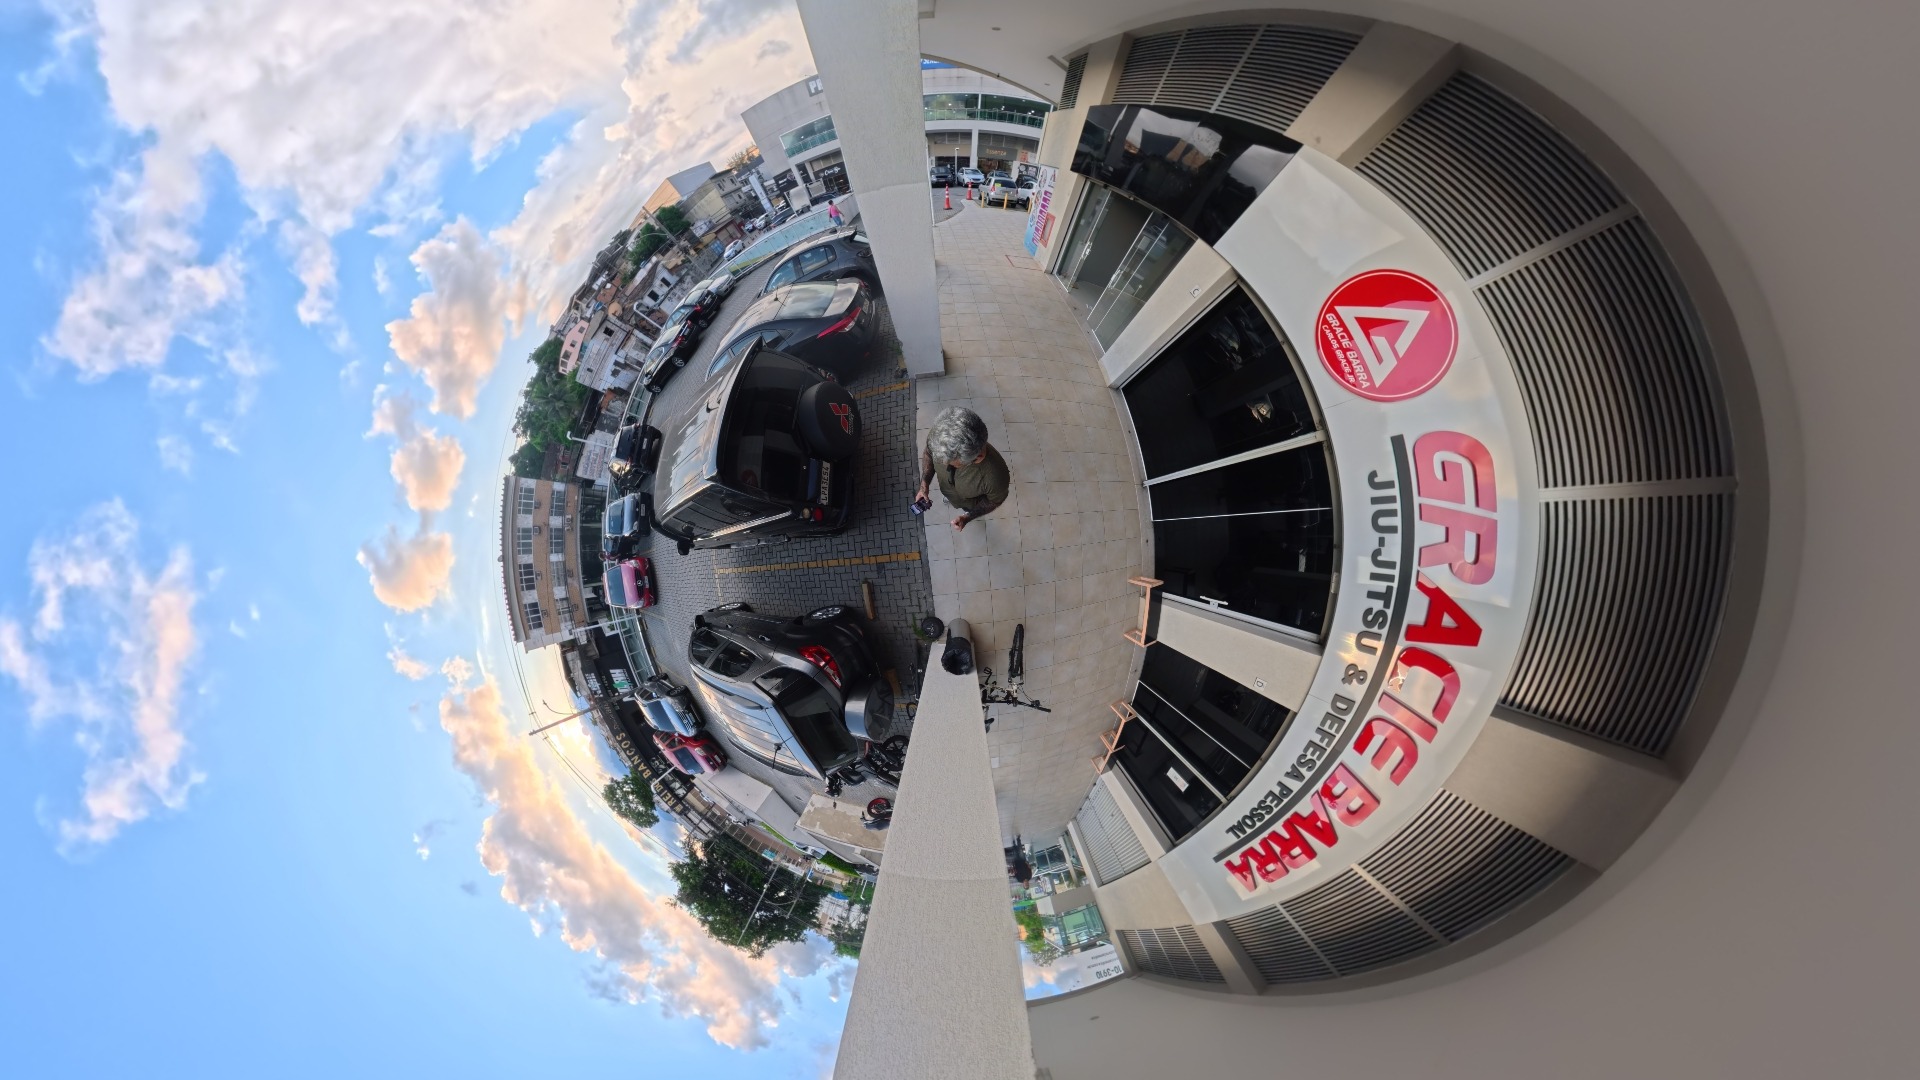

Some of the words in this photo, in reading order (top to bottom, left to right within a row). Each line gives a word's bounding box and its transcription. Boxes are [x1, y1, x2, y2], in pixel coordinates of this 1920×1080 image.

[1322, 325, 1339, 349] CARLOS
[1335, 349, 1351, 373] GRACIE
[1326, 313, 1352, 348] GRACIE
[1346, 351, 1370, 388] BARRA
[1355, 470, 1398, 656] JIU-JITSU
[1353, 431, 1498, 786] GRACIE
[1342, 663, 1367, 685] &
[616, 732, 652, 779] BANCOS
[1284, 693, 1355, 783] DEFESA
[660, 790, 676, 806] REI
[1224, 762, 1380, 892] BARRA
[1225, 781, 1293, 839] PESSOAL
